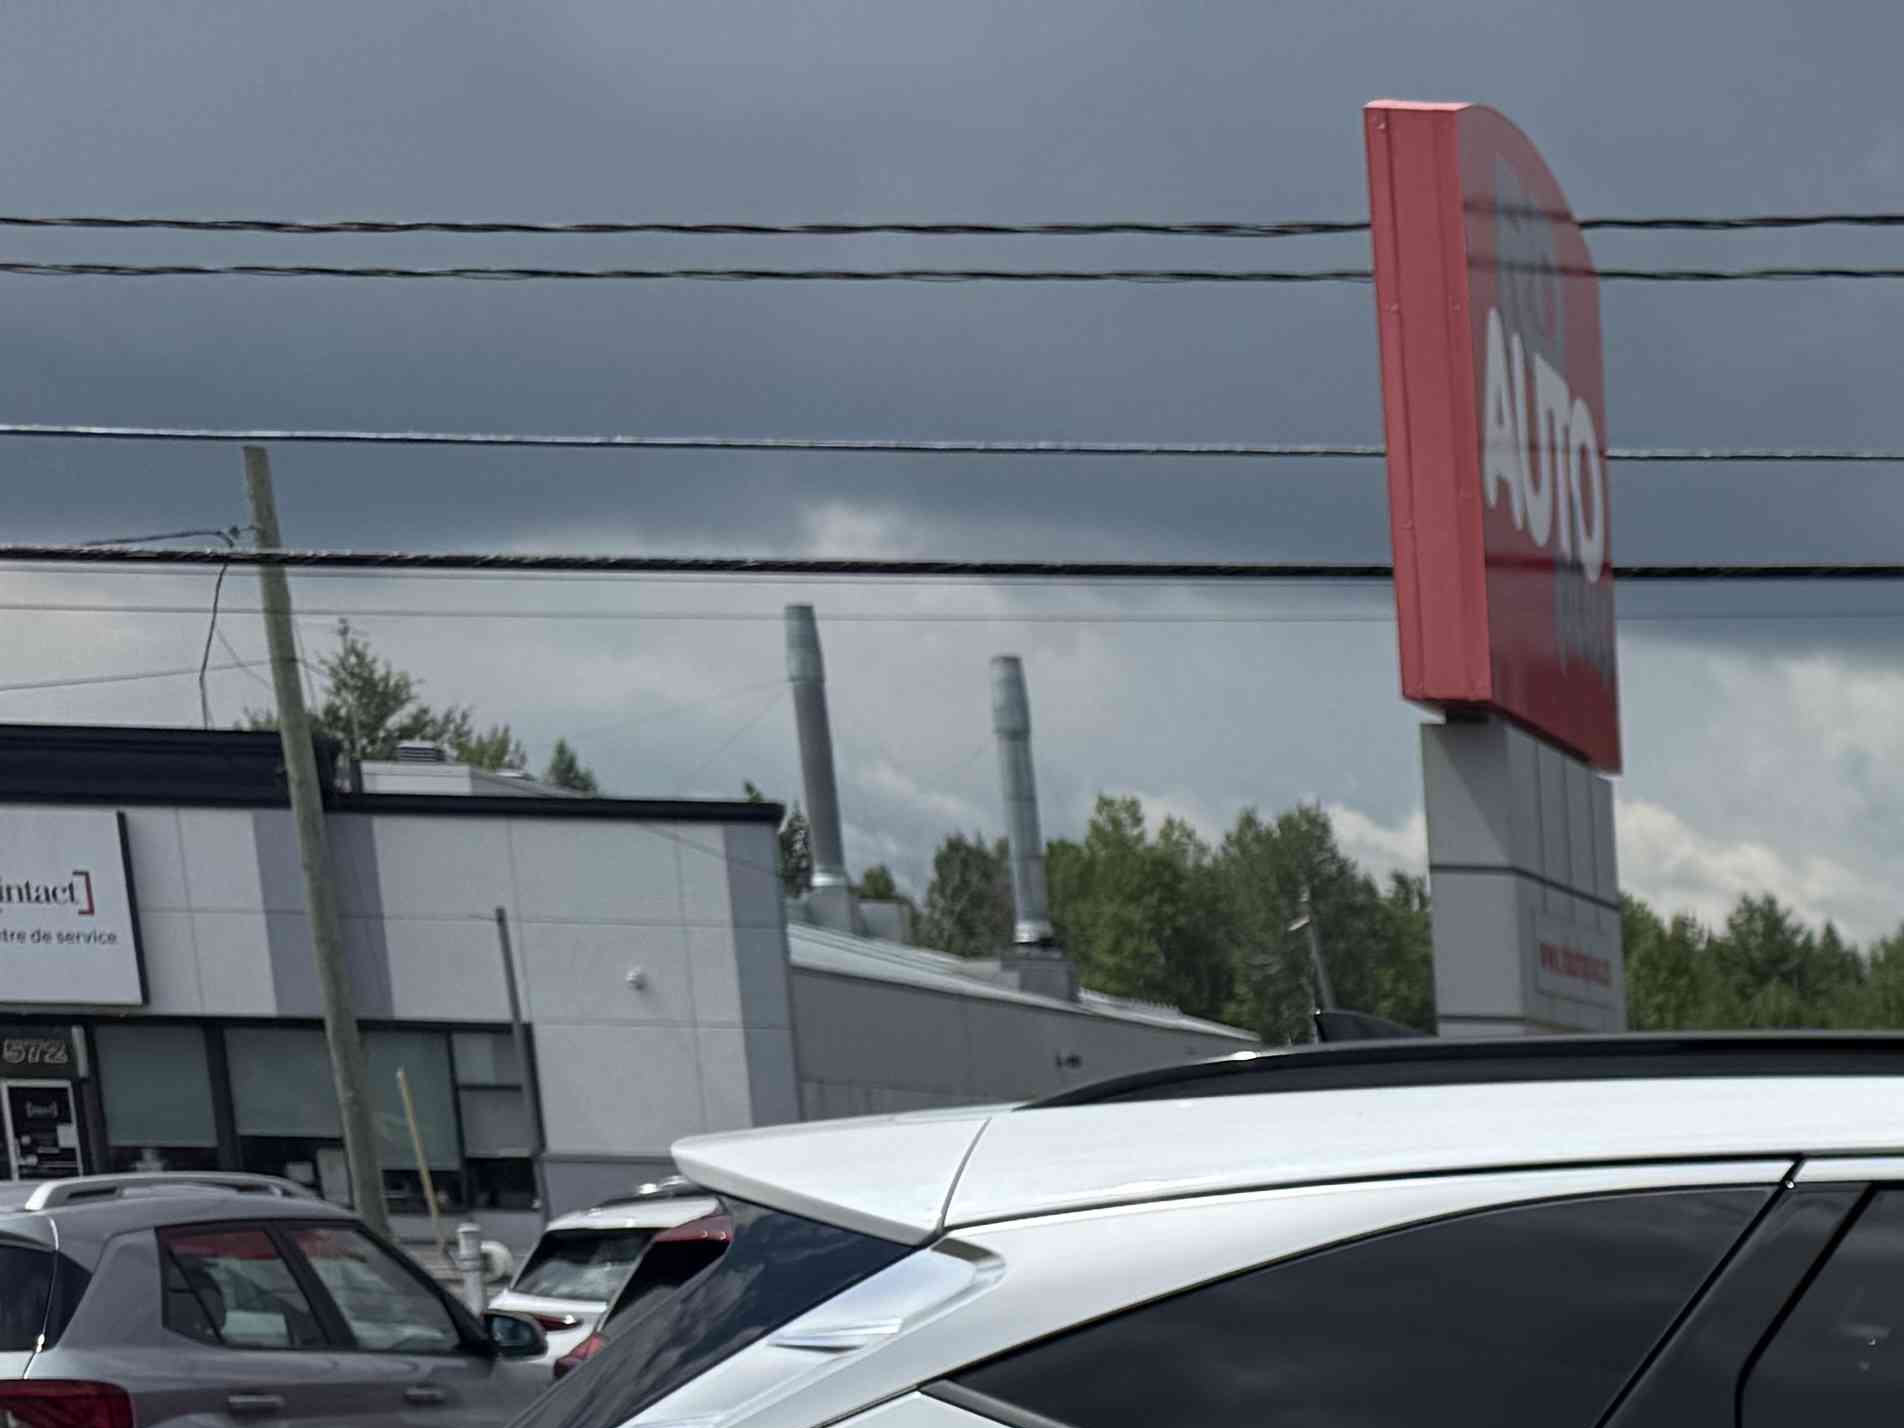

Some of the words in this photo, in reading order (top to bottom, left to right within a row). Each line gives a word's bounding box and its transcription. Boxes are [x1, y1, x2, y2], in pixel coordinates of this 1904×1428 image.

[1482, 306, 1604, 584] AUTO
[30, 928, 52, 944] de
[57, 929, 118, 944] service
